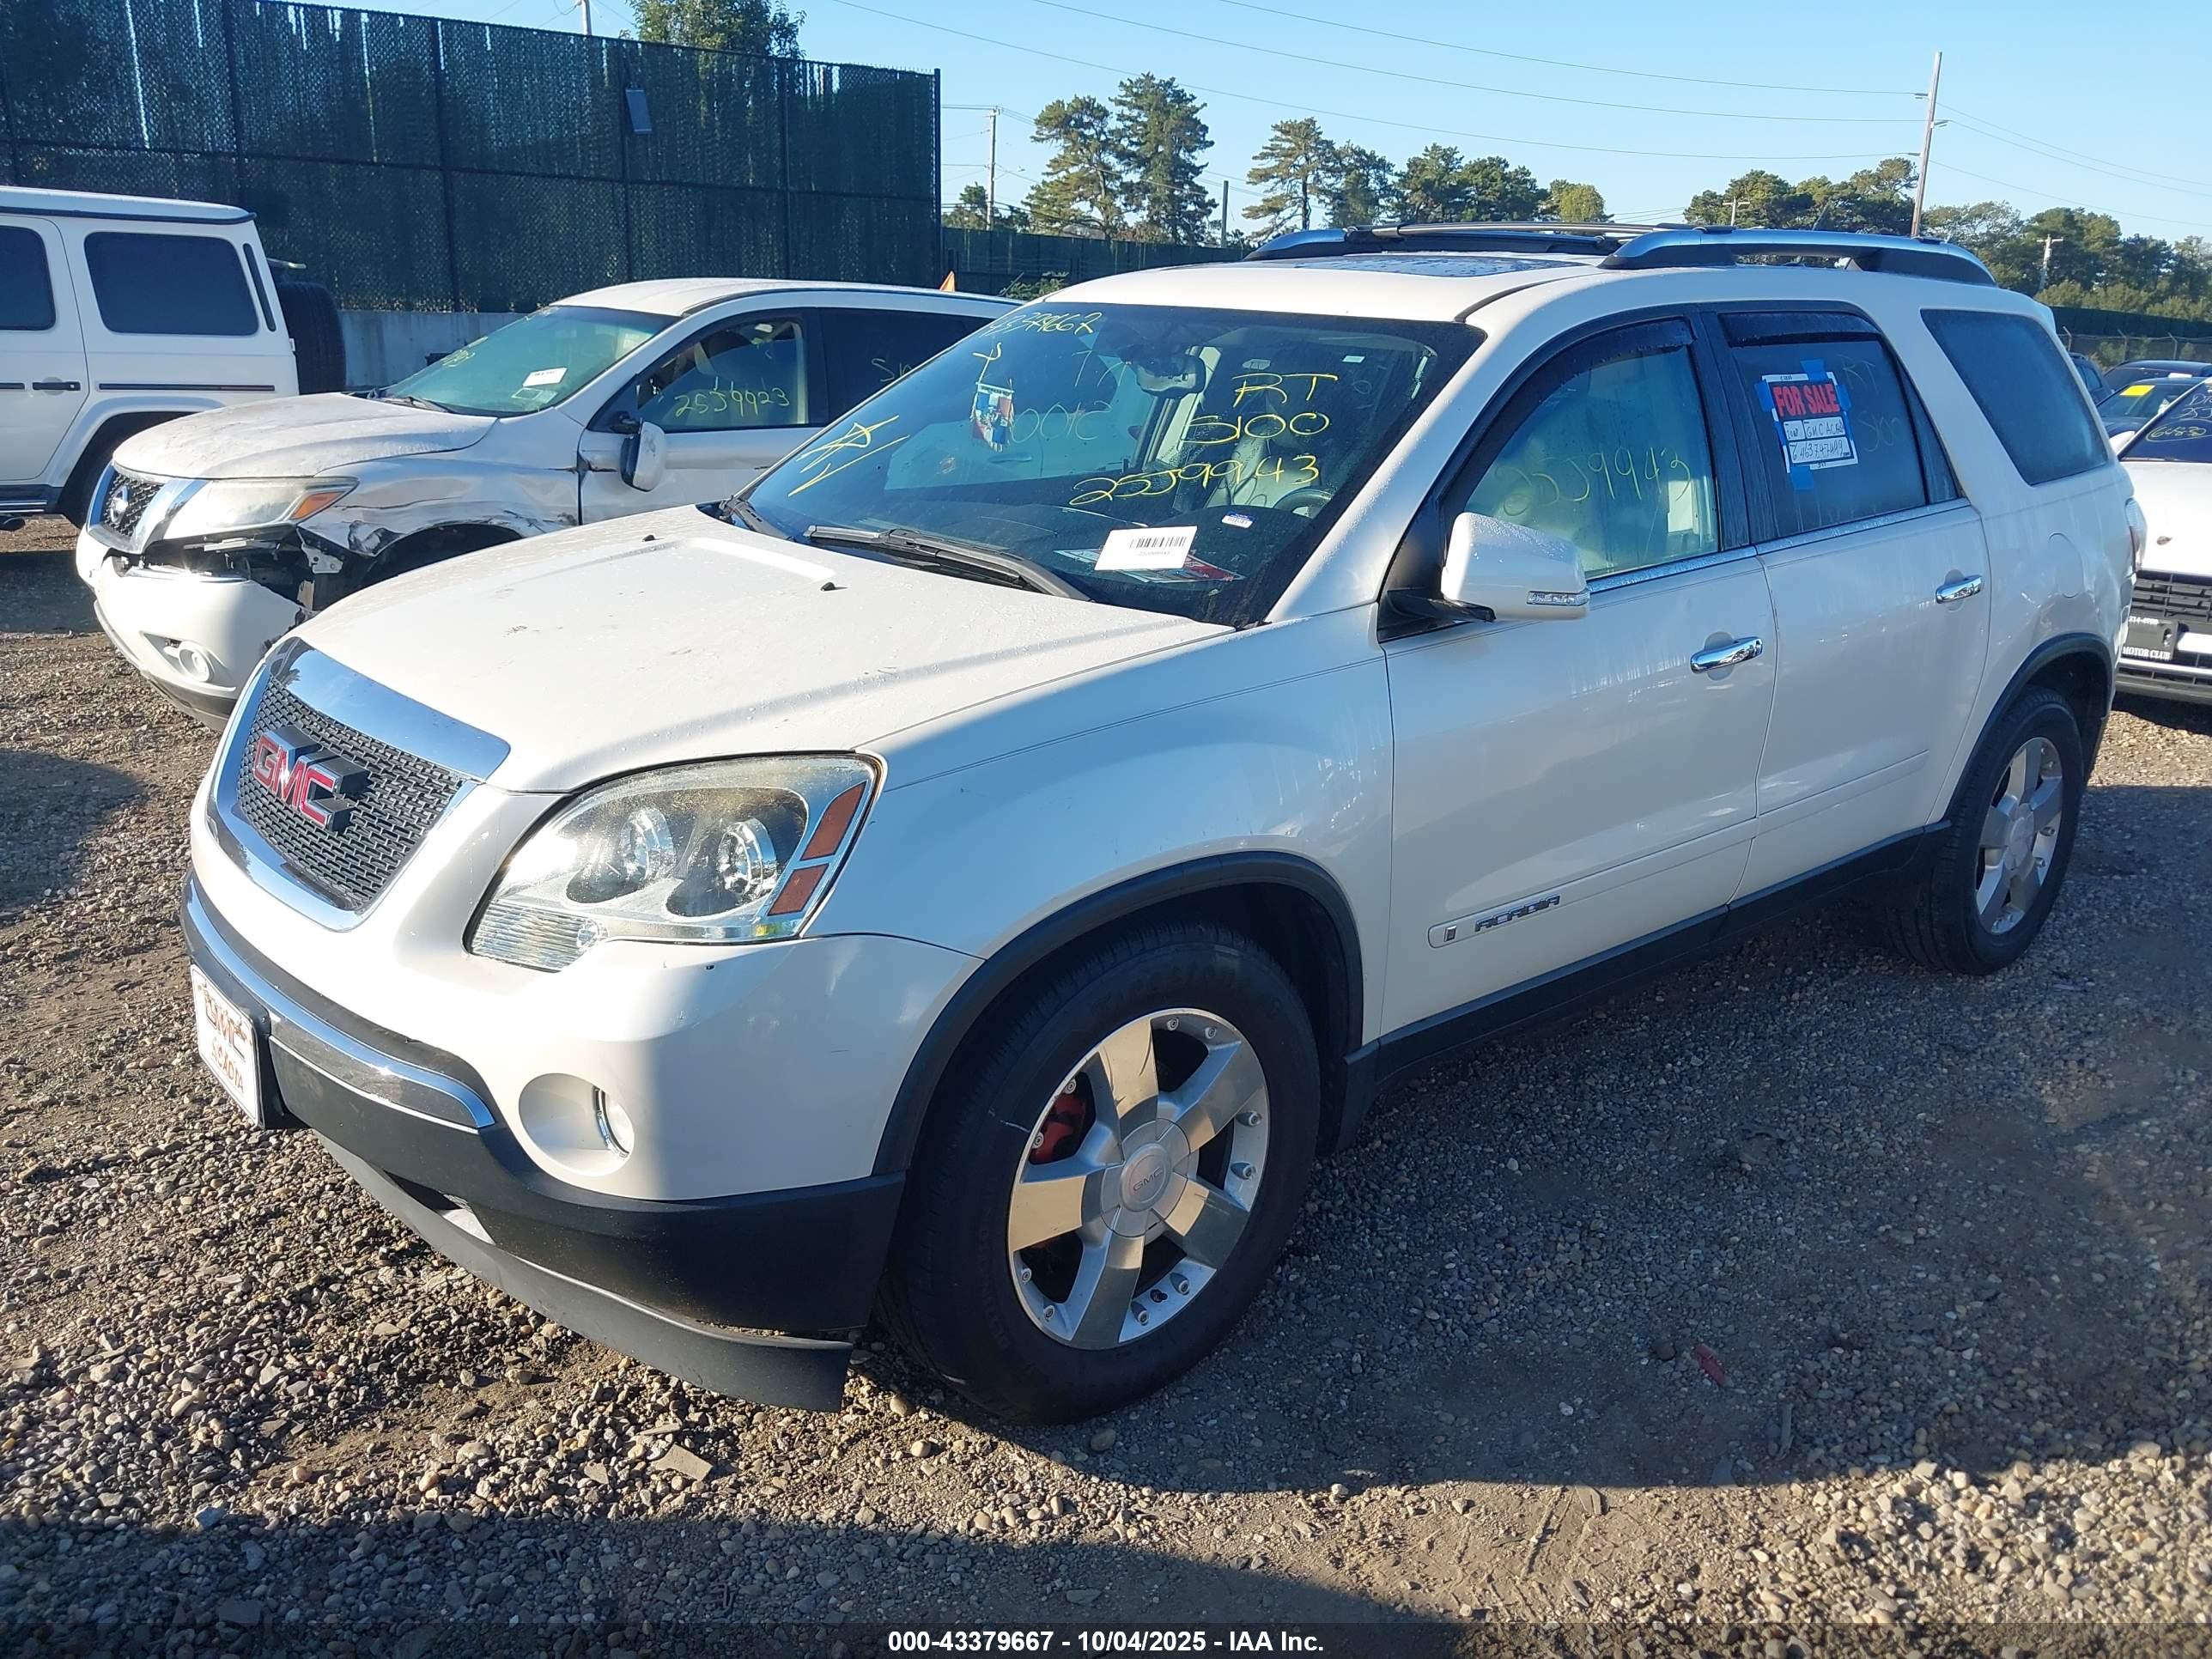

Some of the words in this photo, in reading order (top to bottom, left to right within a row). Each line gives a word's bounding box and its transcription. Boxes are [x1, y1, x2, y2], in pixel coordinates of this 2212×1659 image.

[1231, 373, 1339, 408] RT
[1772, 386, 1806, 417] FOR
[1803, 383, 1841, 414] SALE
[2122, 646, 2149, 657] MOTOR
[2149, 649, 2172, 660] CLUB
[252, 733, 336, 827] GMC
[1474, 894, 1561, 933] ACADIA
[1133, 1167, 1164, 1192] GMC
